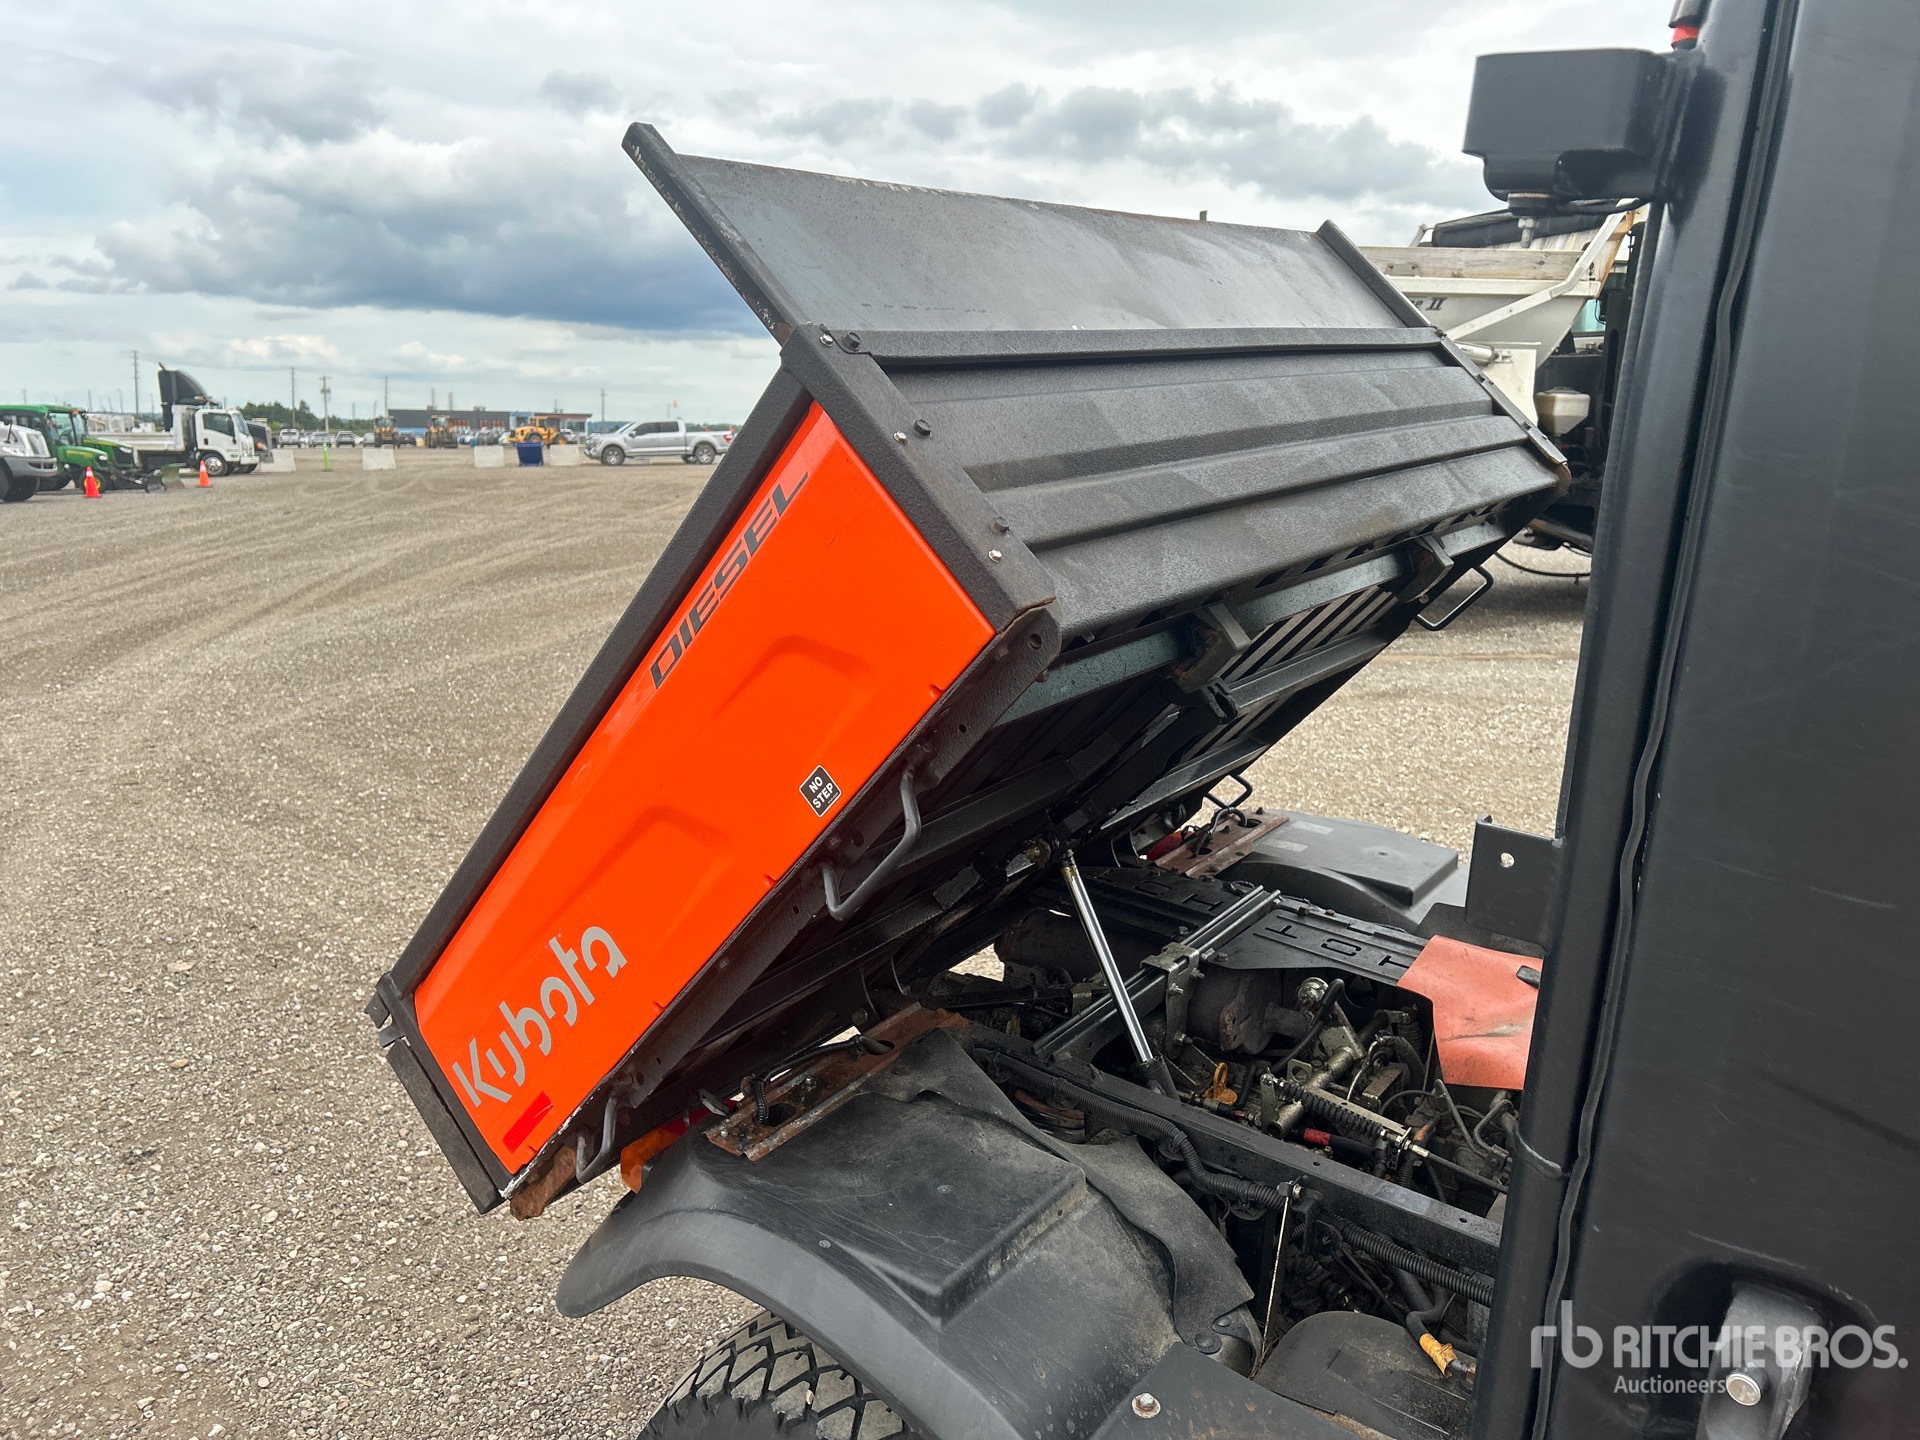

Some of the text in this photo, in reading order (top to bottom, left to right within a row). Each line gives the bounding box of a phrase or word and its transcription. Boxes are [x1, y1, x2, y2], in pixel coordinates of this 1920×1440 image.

[650, 472, 809, 689] DIESEL
[808, 776, 823, 793] NO
[812, 782, 834, 808] STEP
[452, 926, 628, 1107] Kubota
